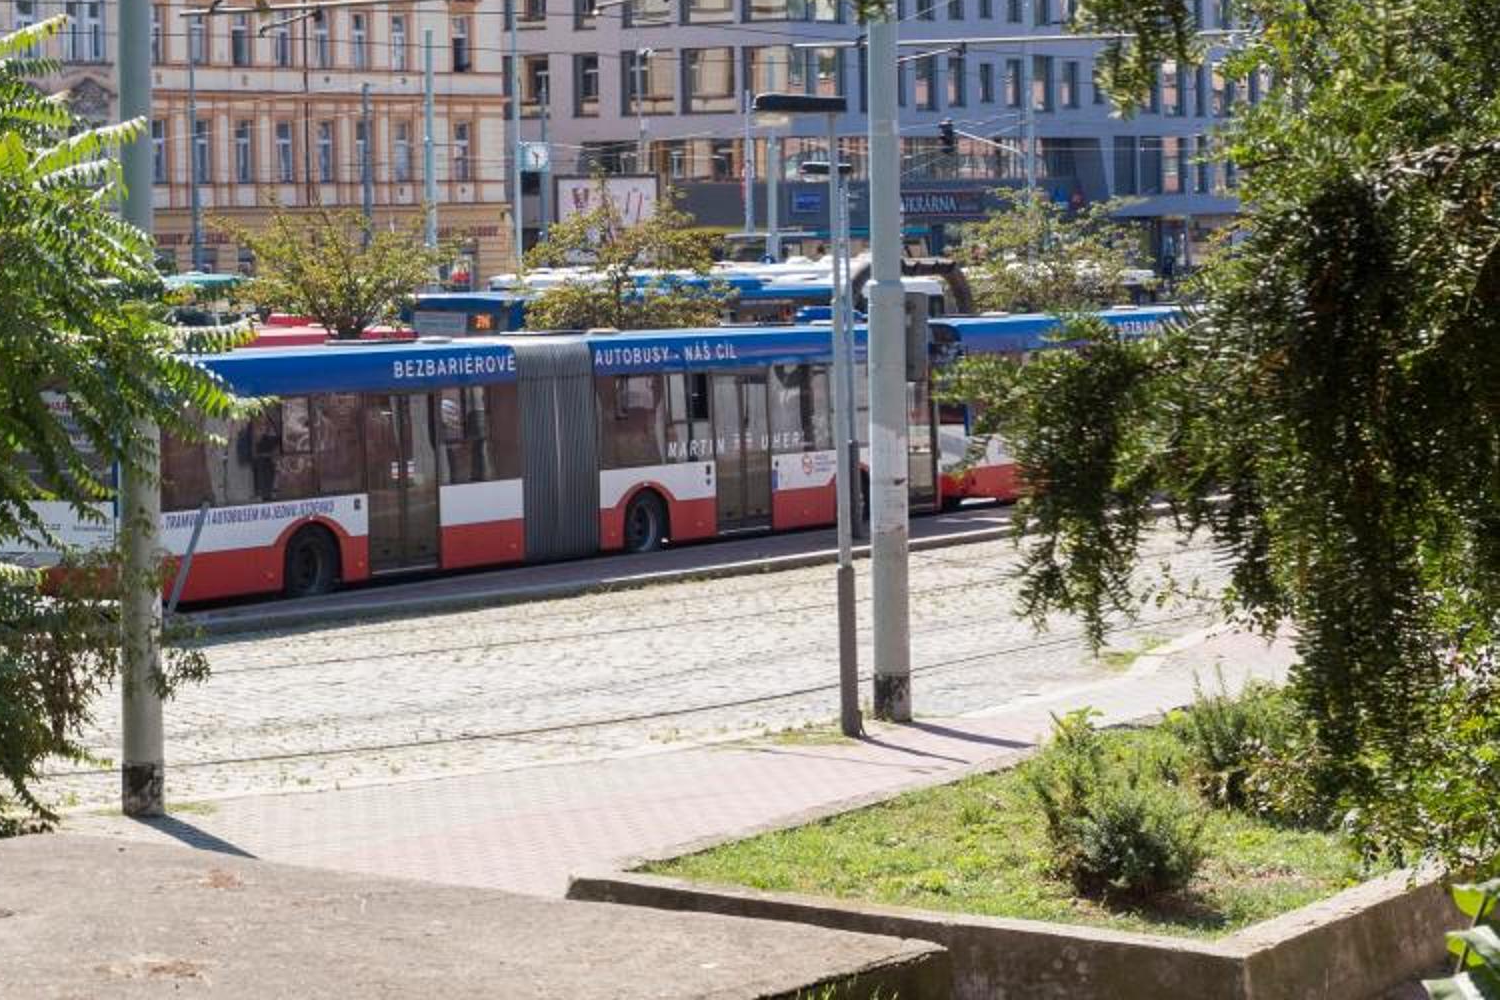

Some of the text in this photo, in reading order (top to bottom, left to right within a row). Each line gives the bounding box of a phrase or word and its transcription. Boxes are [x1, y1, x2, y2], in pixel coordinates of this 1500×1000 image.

[393, 353, 517, 379] BEZBARIÉROVÉ
[595, 346, 669, 366] AUTOBUSY
[684, 340, 711, 361] NÁŠ
[715, 340, 737, 360] CÍL
[667, 431, 800, 457] MARTIN UHER
